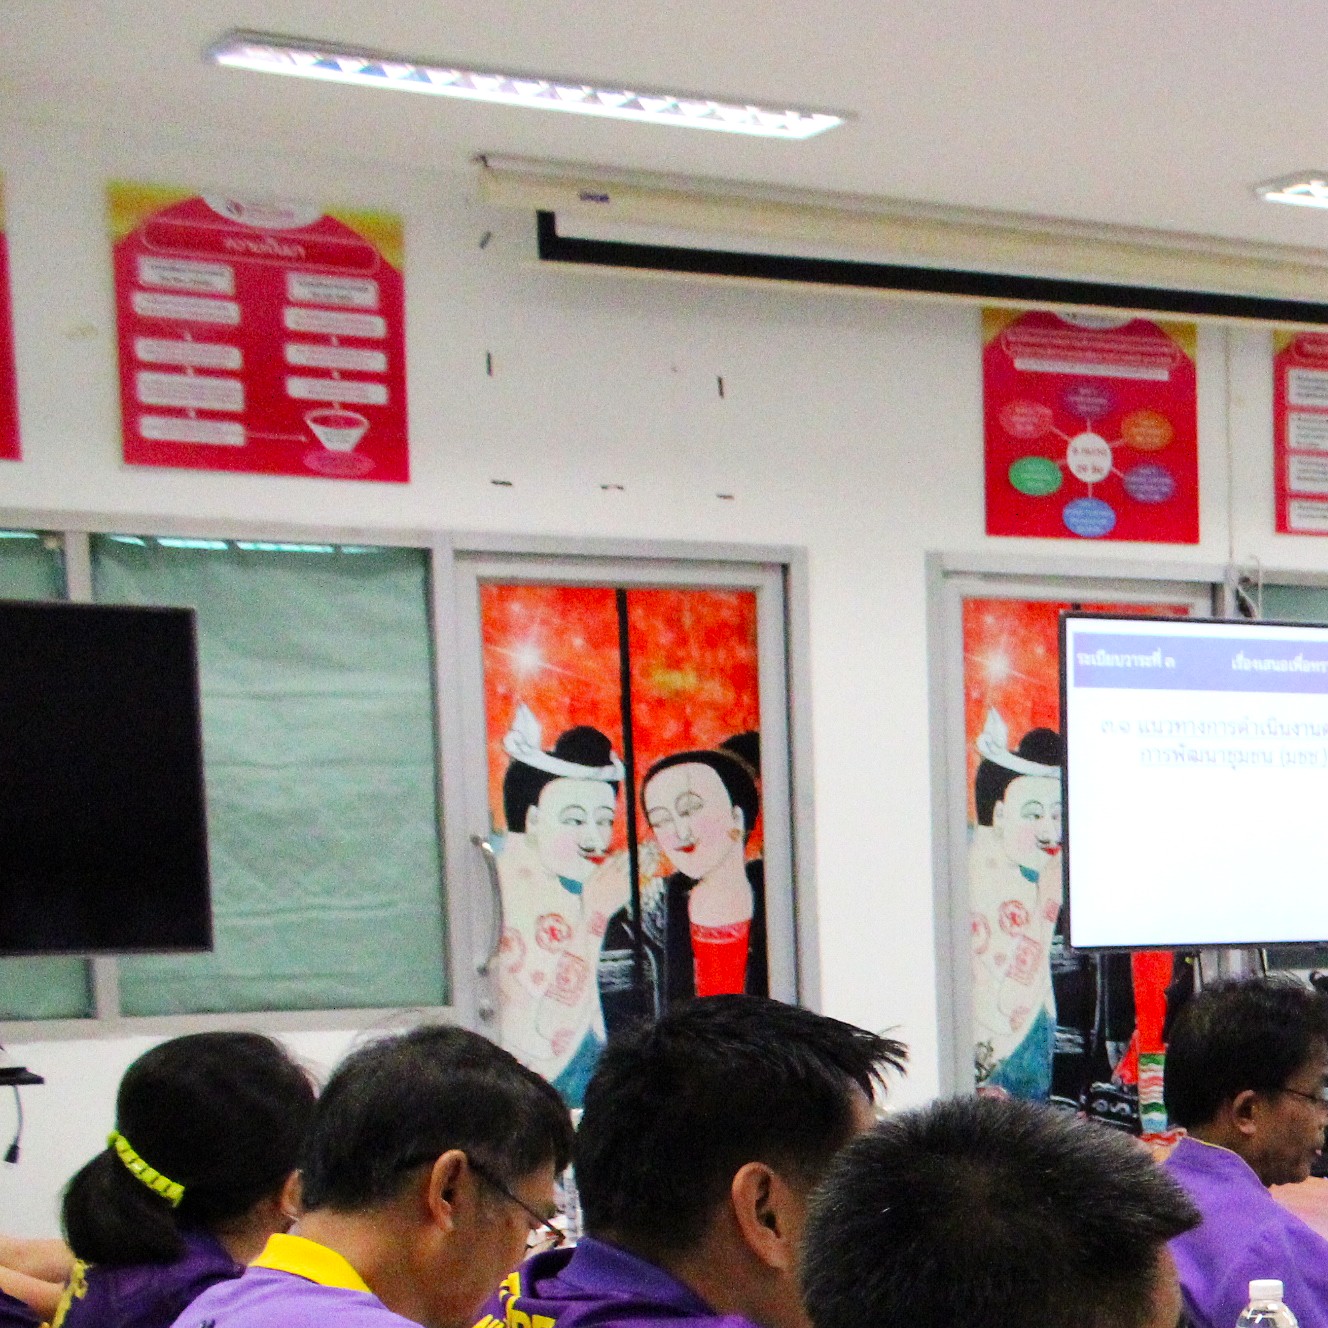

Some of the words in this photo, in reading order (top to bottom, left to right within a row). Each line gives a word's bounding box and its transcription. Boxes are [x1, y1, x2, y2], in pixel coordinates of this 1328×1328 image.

[1138, 742, 1274, 770] การพัฒนาชุมชน
